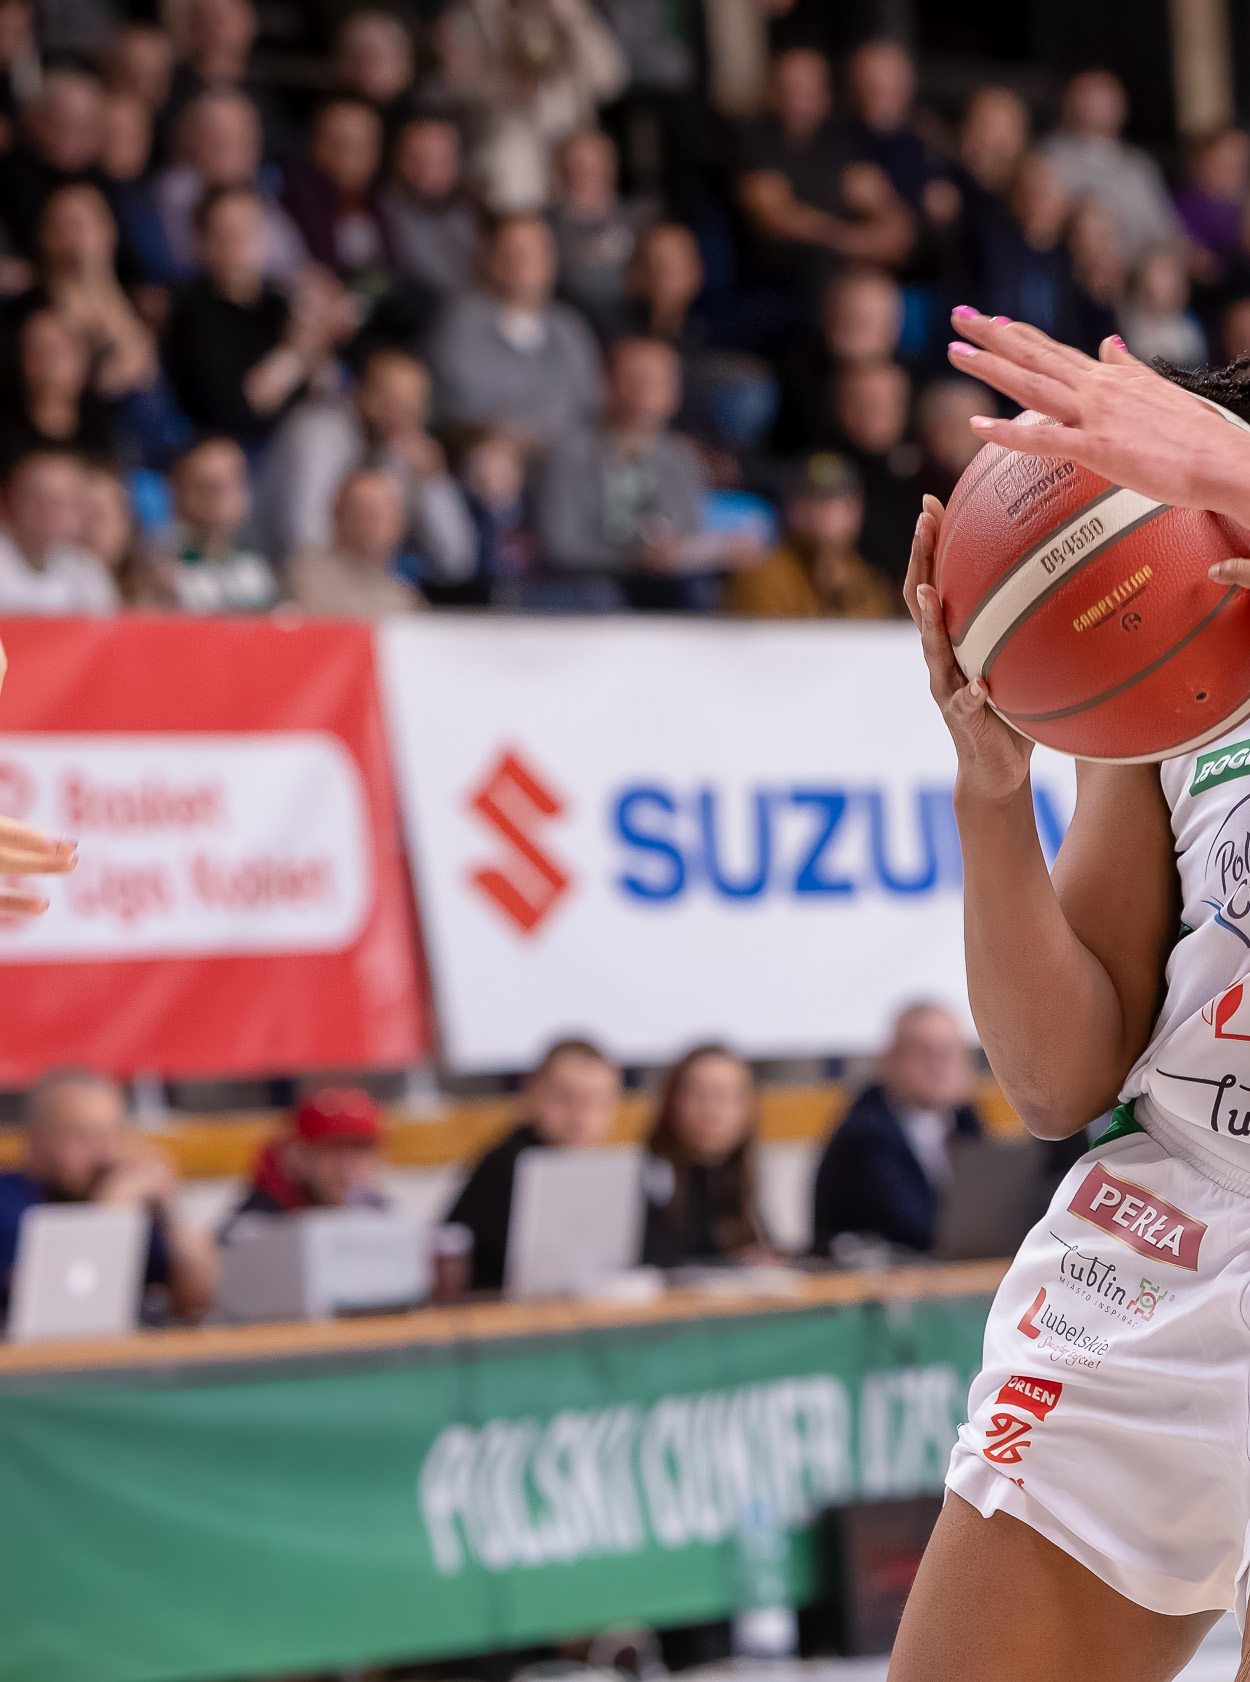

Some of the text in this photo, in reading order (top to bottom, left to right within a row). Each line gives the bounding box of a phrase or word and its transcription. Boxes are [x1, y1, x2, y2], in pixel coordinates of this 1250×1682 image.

[1007, 461, 1075, 520] APPROVED
[611, 780, 1066, 902] SUZU
[1089, 1182, 1184, 1258] PERŁA
[1058, 1276, 1092, 1302] MIASTO
[1007, 1377, 1056, 1406] ORLEN
